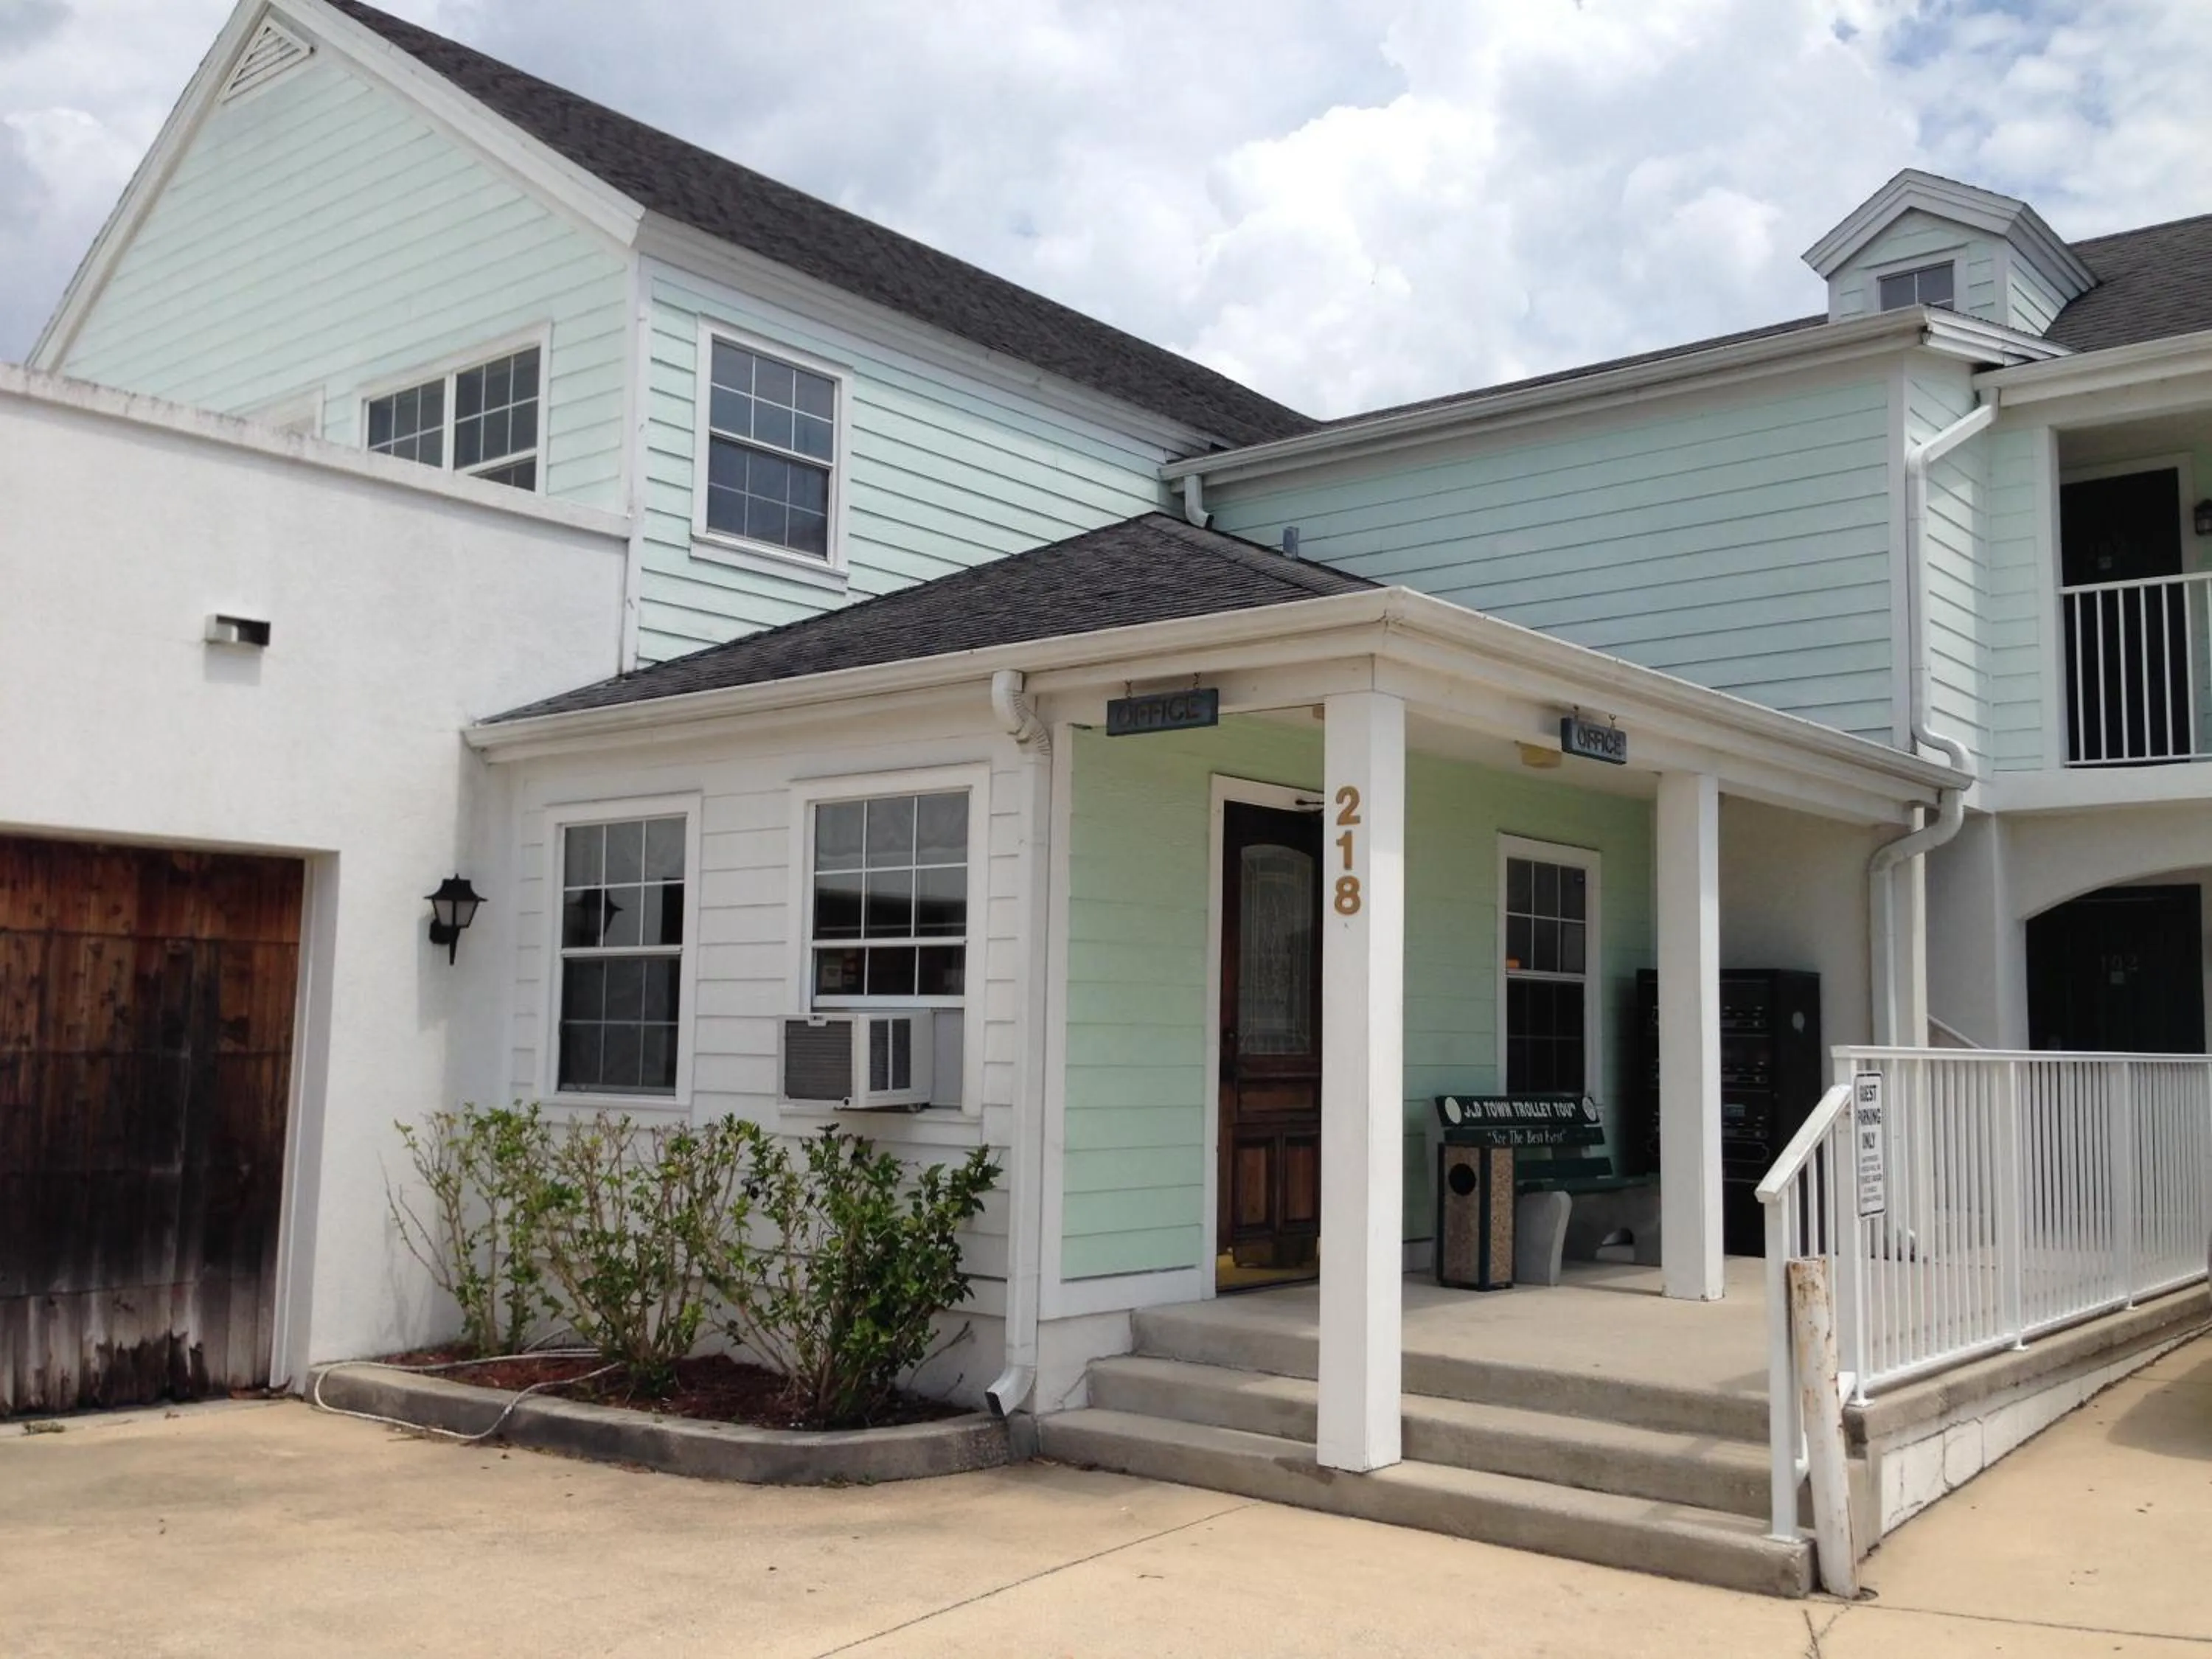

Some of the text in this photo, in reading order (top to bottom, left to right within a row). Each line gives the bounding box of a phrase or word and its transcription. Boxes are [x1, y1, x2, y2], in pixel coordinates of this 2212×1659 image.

[1117, 691, 1203, 727] OFFICE
[1576, 724, 1622, 757] OFFICE
[1334, 785, 1361, 916] 218
[1483, 1101, 1513, 1118] TOWN
[1512, 1101, 1552, 1118] TROLLEY
